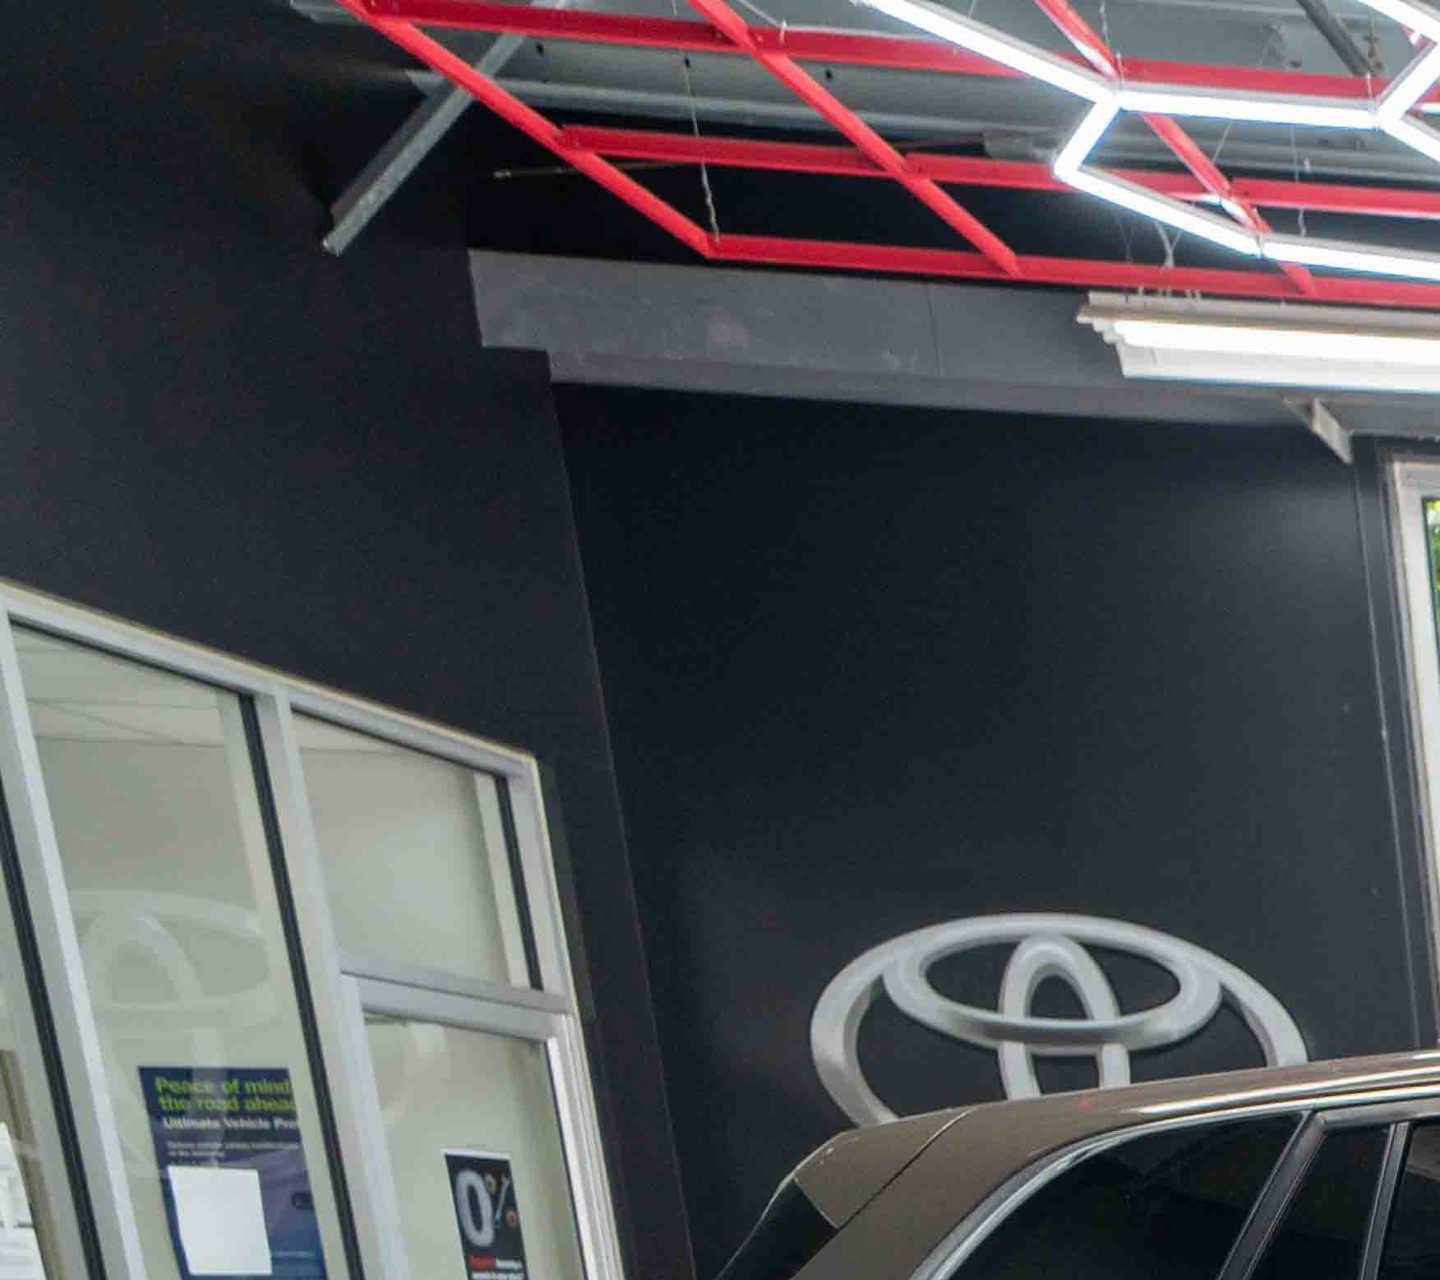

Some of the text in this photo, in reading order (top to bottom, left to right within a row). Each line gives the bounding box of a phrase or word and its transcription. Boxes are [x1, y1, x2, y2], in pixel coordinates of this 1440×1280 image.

[154, 1076, 214, 1095] Peace
[222, 1077, 240, 1095] of
[158, 1095, 190, 1112] the
[197, 1097, 241, 1112] road
[163, 1116, 221, 1130] Ultimate
[224, 1116, 270, 1130] Vehicle
